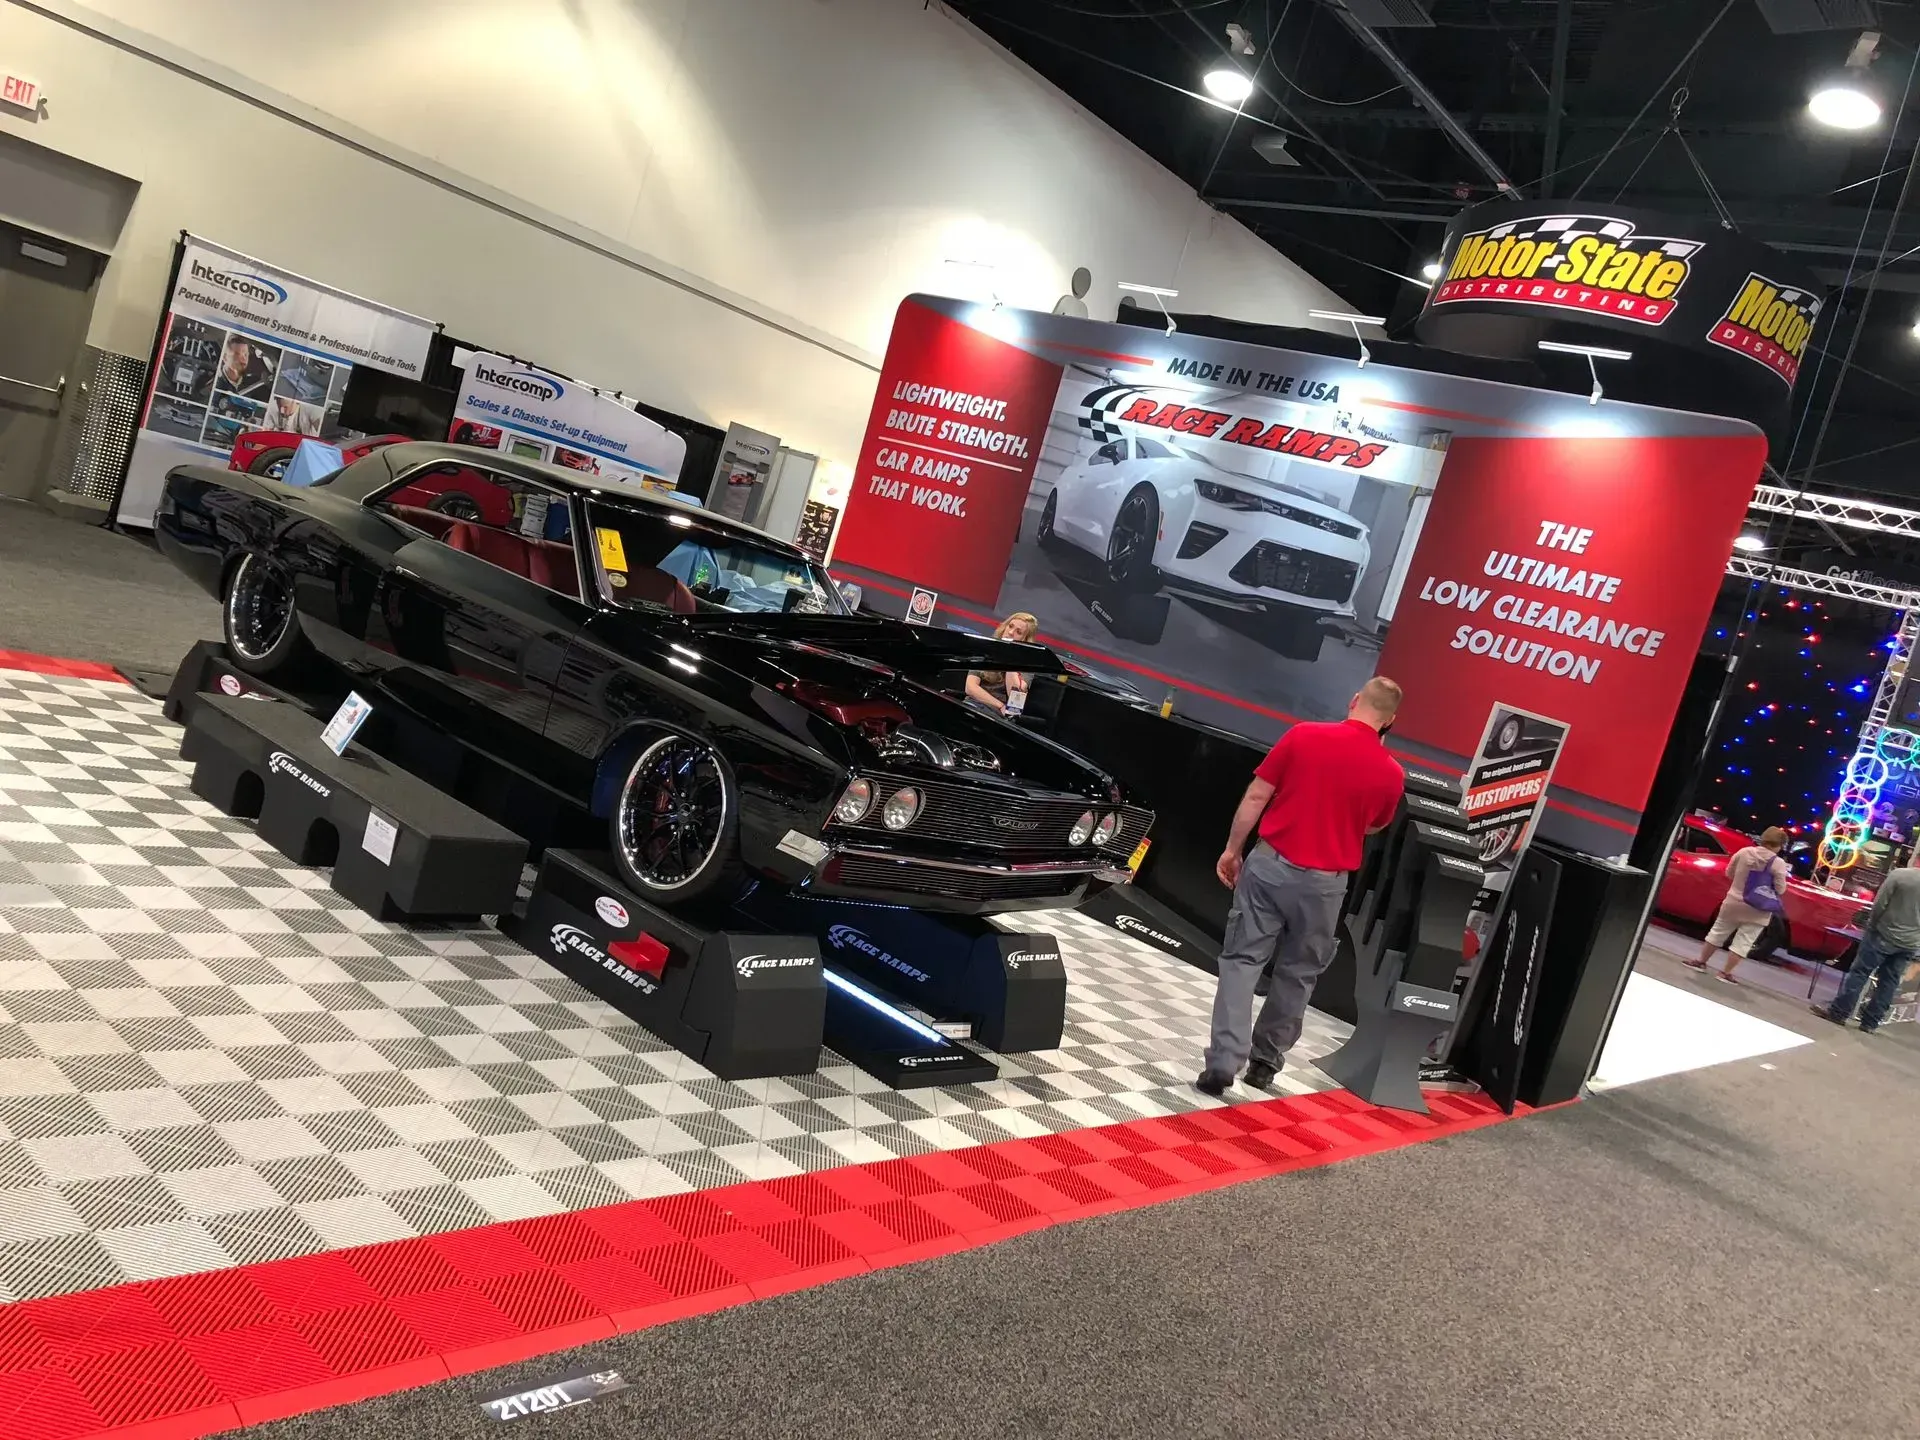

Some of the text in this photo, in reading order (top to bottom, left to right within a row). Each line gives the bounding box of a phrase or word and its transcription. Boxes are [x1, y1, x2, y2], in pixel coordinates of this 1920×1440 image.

[4, 76, 35, 104] EXIT
[191, 259, 276, 305] Intercomp
[1447, 235, 1686, 299] Motor State
[1442, 283, 1659, 316] DISTRIBUTING
[178, 287, 220, 309] Portable
[221, 303, 270, 326] Alignment
[270, 320, 309, 339] Systems
[310, 333, 317, 342] &
[319, 335, 371, 357] Professional
[371, 351, 396, 366] Grade
[396, 359, 417, 372] Tools
[475, 364, 553, 401] Intercomp
[892, 380, 1007, 422] LIGHTWEIGHT.
[1167, 357, 1340, 404] MADE IN THE USA
[466, 395, 628, 453] Scales & Chassis Set-up Equipment
[885, 409, 1029, 459] BRUTE STRENGTH.
[1119, 398, 1389, 469] RACE RAMPS
[735, 440, 766, 456] Intercomp
[875, 448, 971, 487] CAR RAMPS
[868, 475, 967, 518] THAT WORK.
[1536, 520, 1593, 554] THE
[1483, 550, 1621, 603] ULTIMATE
[1419, 576, 1666, 658] LOW CLEARANCE
[1450, 625, 1602, 684] SOLUTION
[279, 757, 331, 798] RACE RAMPS
[1463, 778, 1542, 811] FLATSTOPPERS
[1124, 918, 1182, 949] RACE RAMPS
[567, 934, 655, 996] RACE RAMPS
[750, 956, 816, 969] RACE RAMPS
[845, 933, 929, 984] RACE RAMPS
[1015, 952, 1058, 963] RACE RAMPS
[910, 1055, 964, 1065] RACE RAMPS
[491, 1384, 572, 1421] 21201
